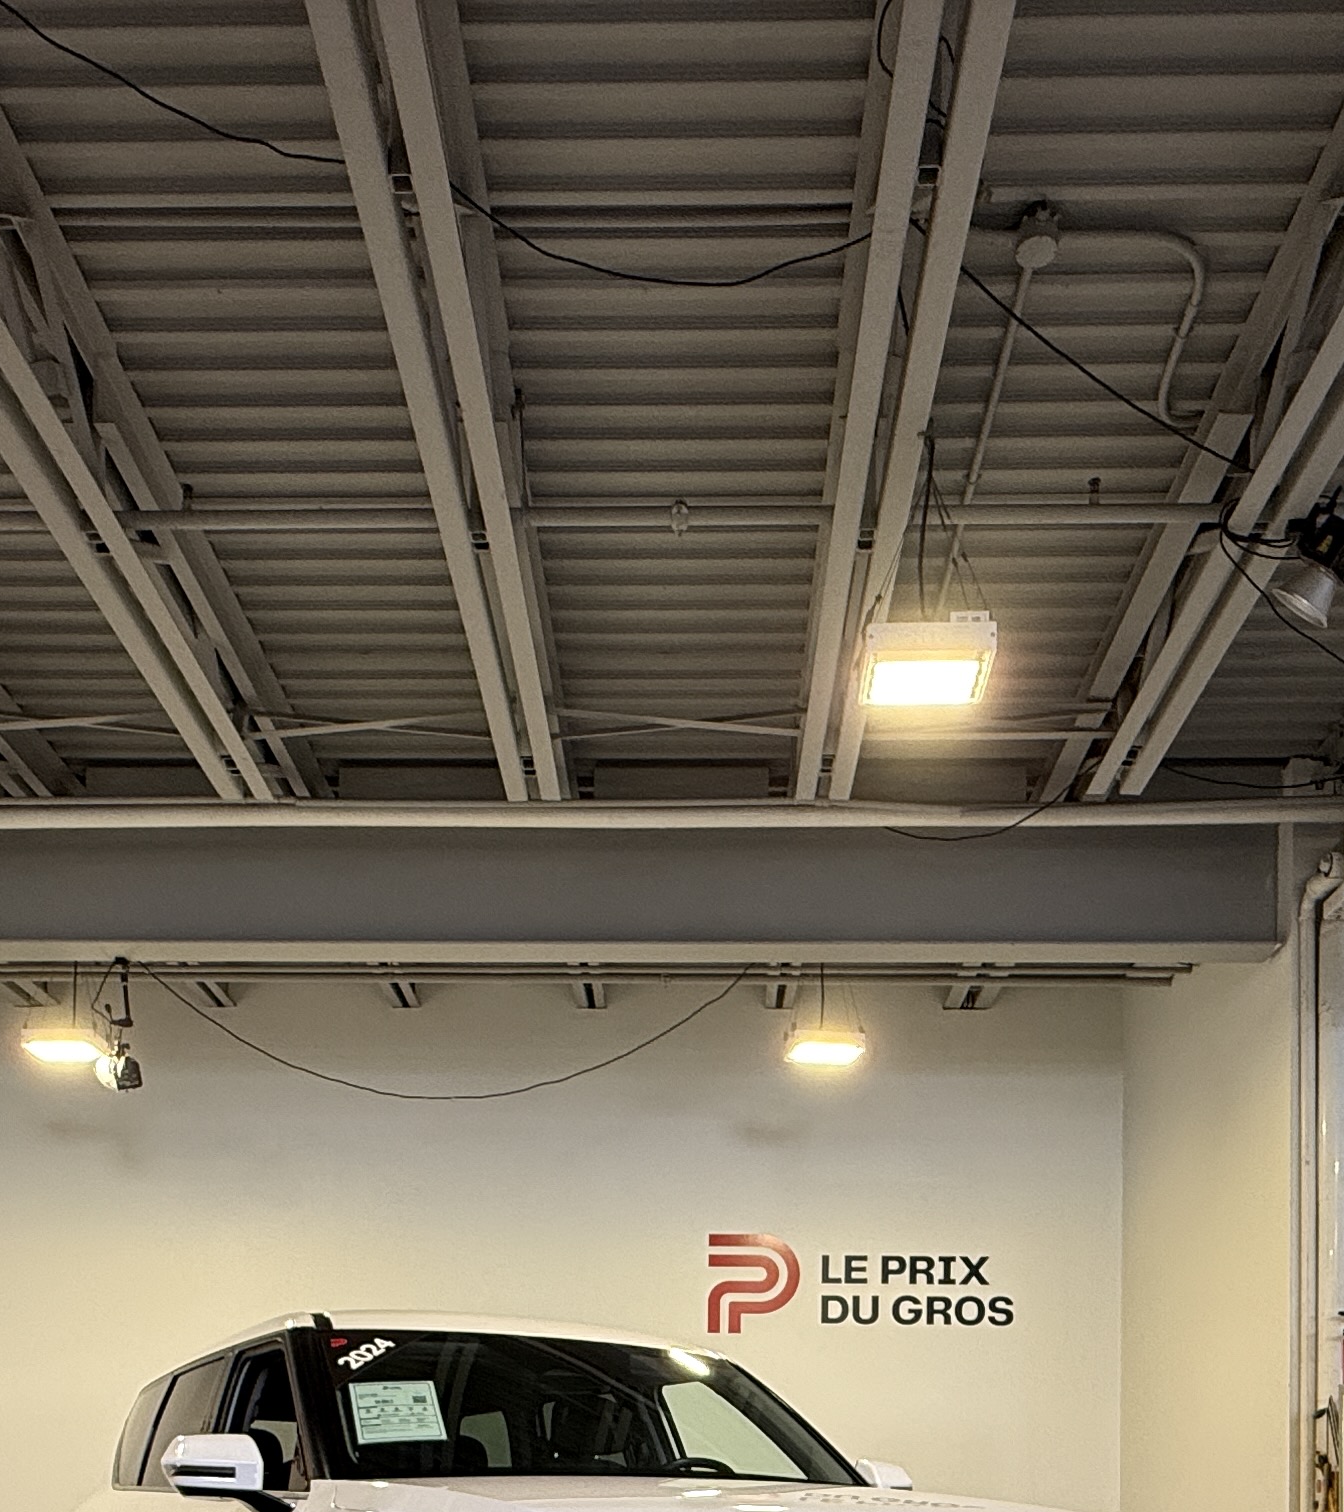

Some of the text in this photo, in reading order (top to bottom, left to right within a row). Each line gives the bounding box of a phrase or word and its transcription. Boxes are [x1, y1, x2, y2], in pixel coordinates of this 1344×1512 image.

[821, 1254, 990, 1285] LE PRIX
[820, 1295, 1014, 1326] DU GROS
[337, 1337, 396, 1370] 2024
